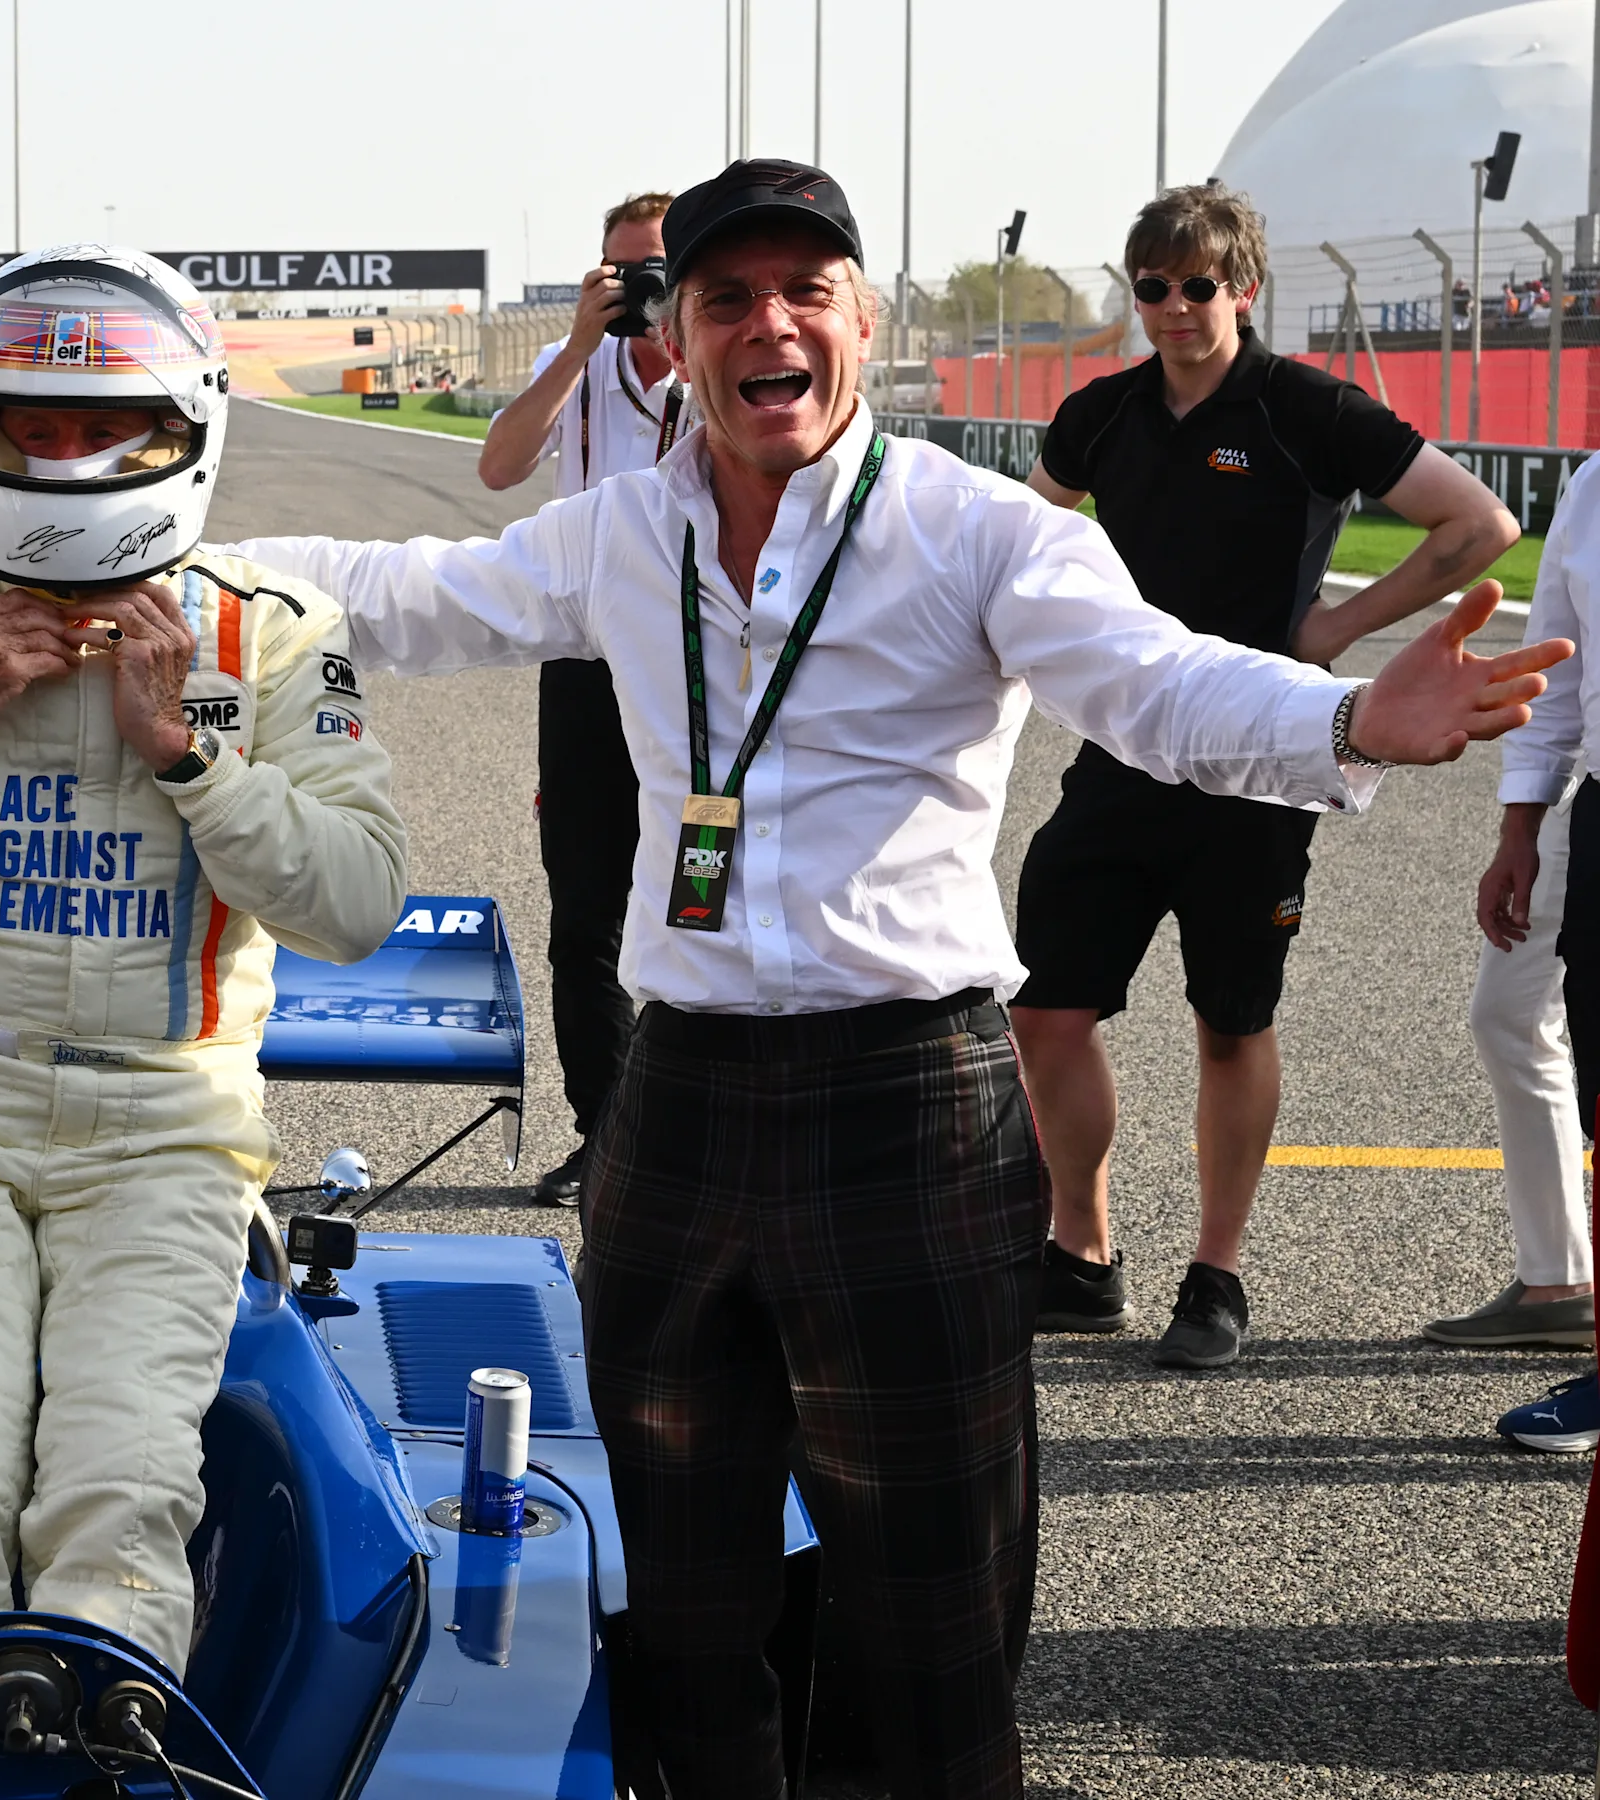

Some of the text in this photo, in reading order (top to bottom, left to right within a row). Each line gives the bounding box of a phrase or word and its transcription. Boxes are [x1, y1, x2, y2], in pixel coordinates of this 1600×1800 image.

[314, 253, 394, 287] AIR
[57, 345, 82, 360] elf
[165, 421, 186, 429] BELL
[1216, 447, 1247, 459] HALL
[1216, 456, 1250, 468] HALL
[316, 711, 362, 742] GPR
[683, 847, 727, 869] PDK
[682, 864, 721, 880] 2025
